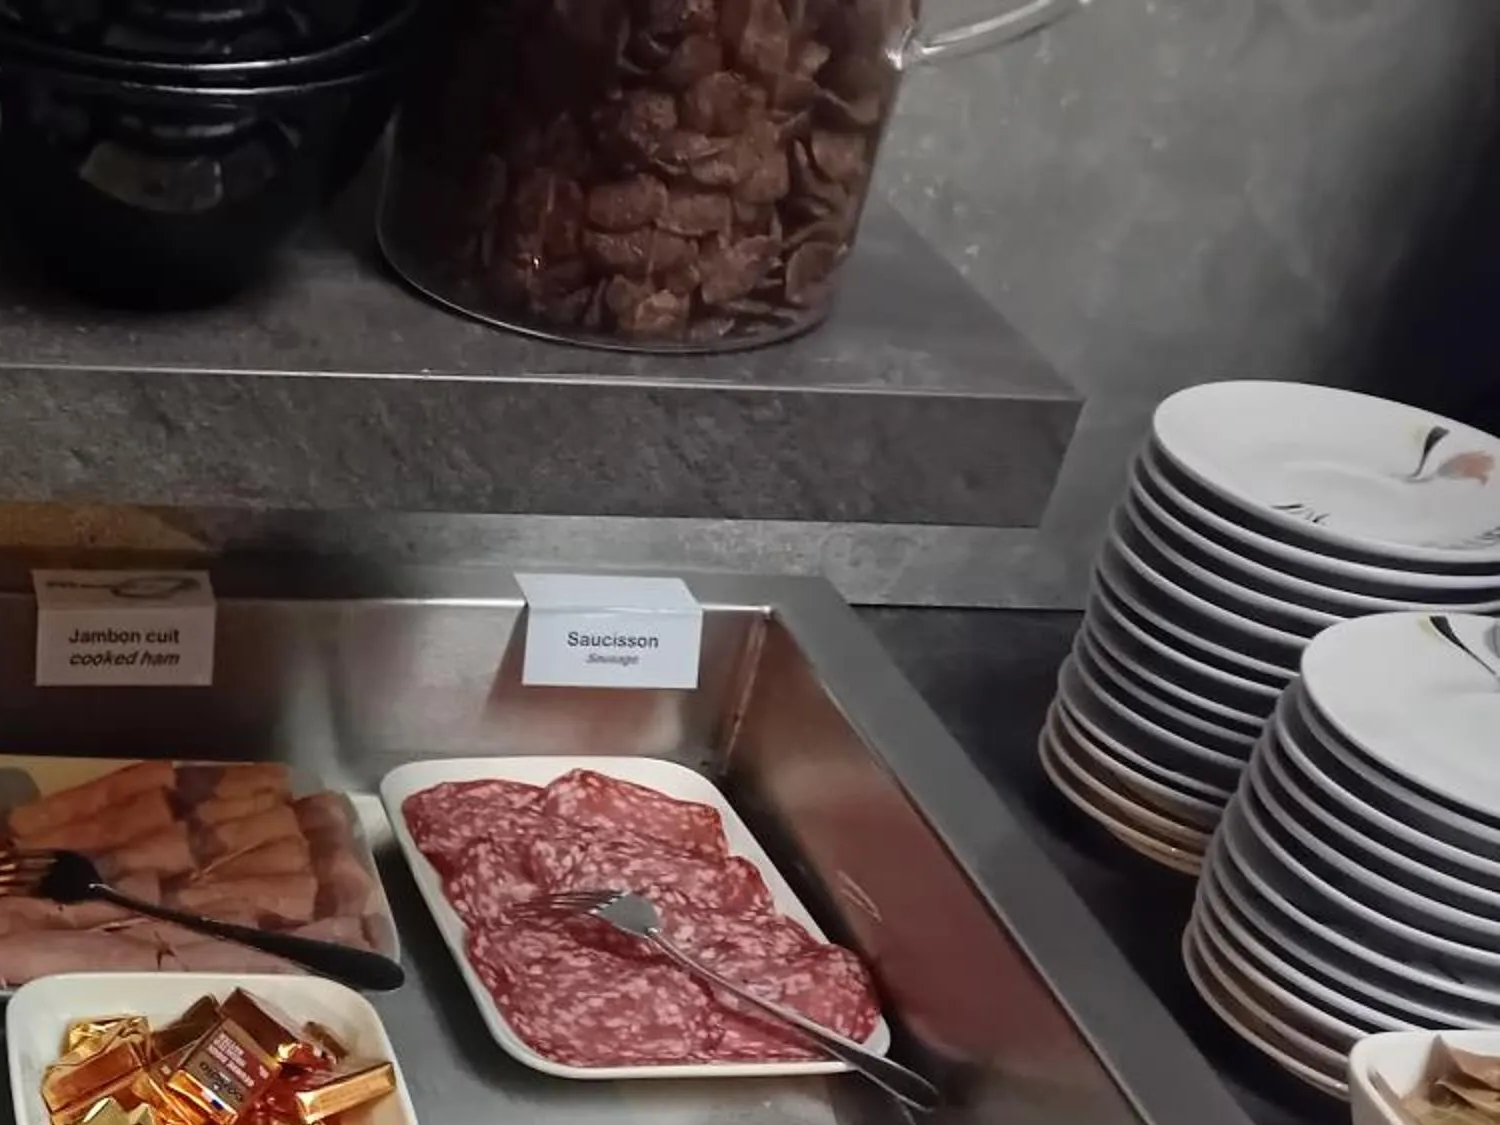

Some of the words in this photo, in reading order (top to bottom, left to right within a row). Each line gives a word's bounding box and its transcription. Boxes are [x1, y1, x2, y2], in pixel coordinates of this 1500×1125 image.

[68, 627, 142, 645] Jambon
[146, 628, 180, 644] cuit
[567, 631, 659, 649] Saucisson
[69, 651, 138, 667] cooked
[140, 651, 181, 667] ham
